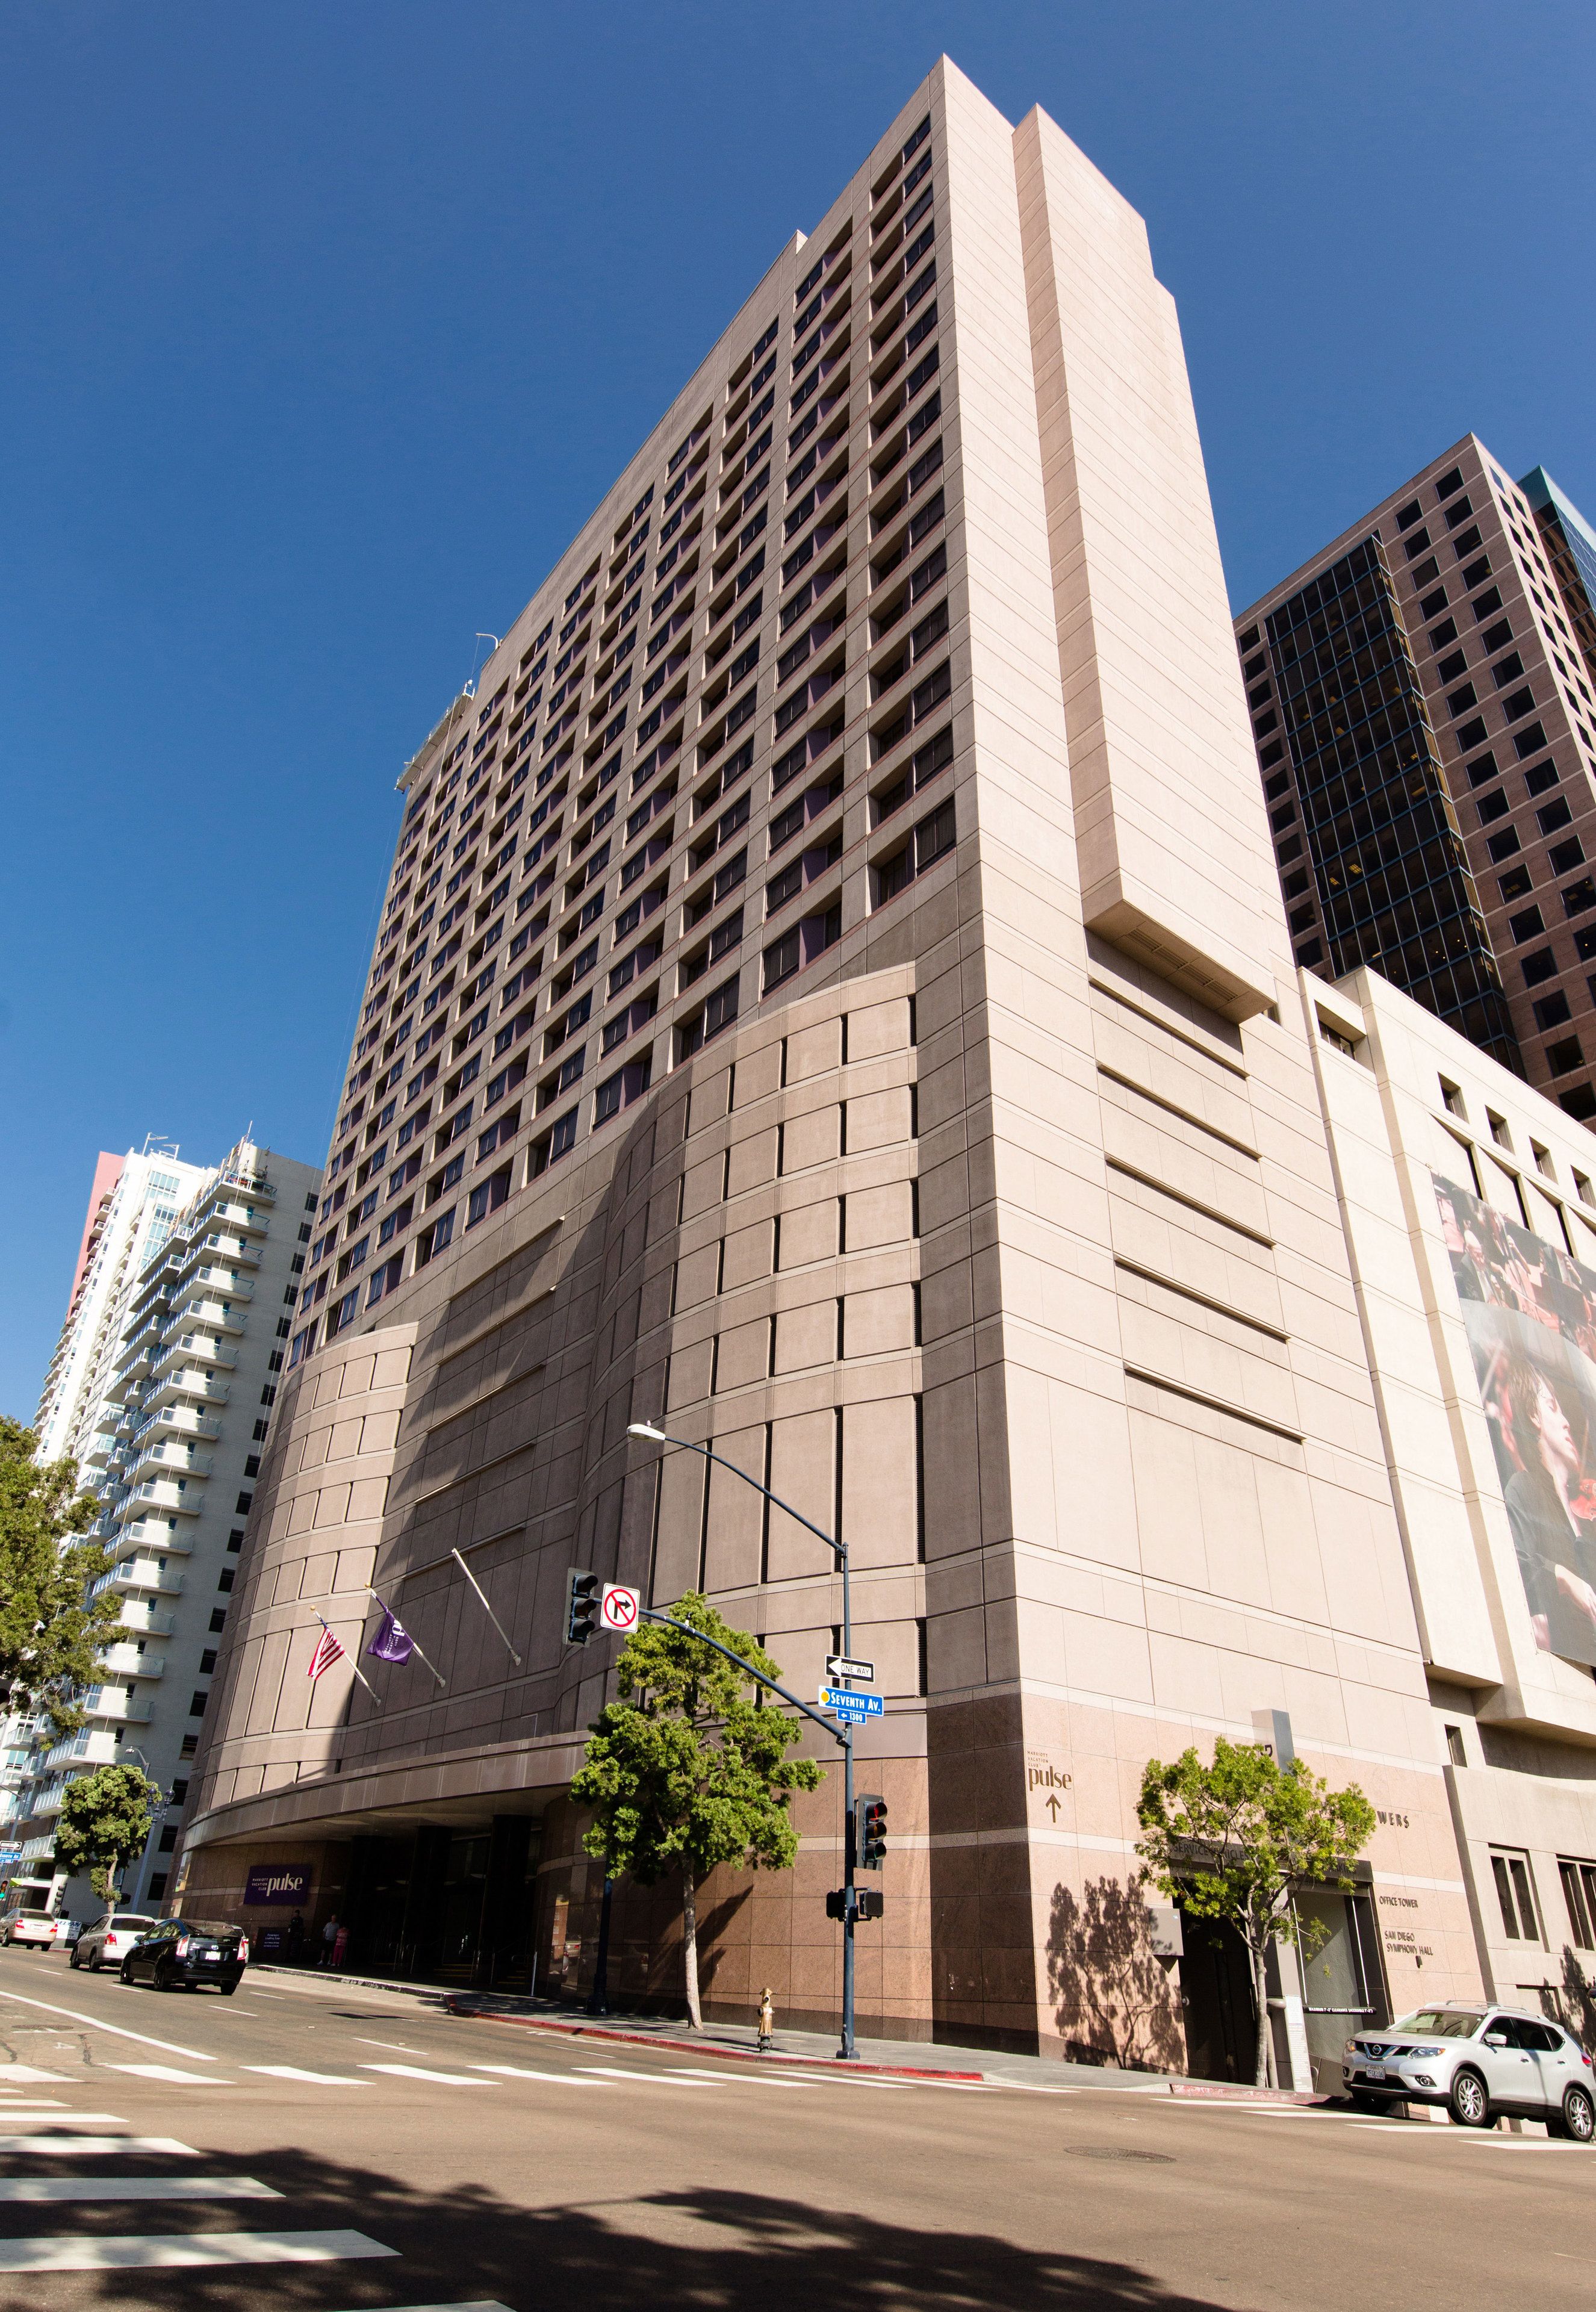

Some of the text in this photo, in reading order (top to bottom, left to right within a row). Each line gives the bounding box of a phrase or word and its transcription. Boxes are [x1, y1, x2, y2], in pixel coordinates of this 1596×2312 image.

[840, 1664, 870, 1676] ONE WAY
[849, 1712, 863, 1722] 1300
[1028, 1765, 1072, 1792] pulse
[1376, 1810, 1409, 1829] WERS
[266, 1873, 303, 1897] pulse
[1379, 1895, 1418, 1909] OFFICE TOWER
[1384, 1930, 1415, 1942] SAN DIEGO
[1386, 1942, 1433, 1956] SYMPHONY HALL
